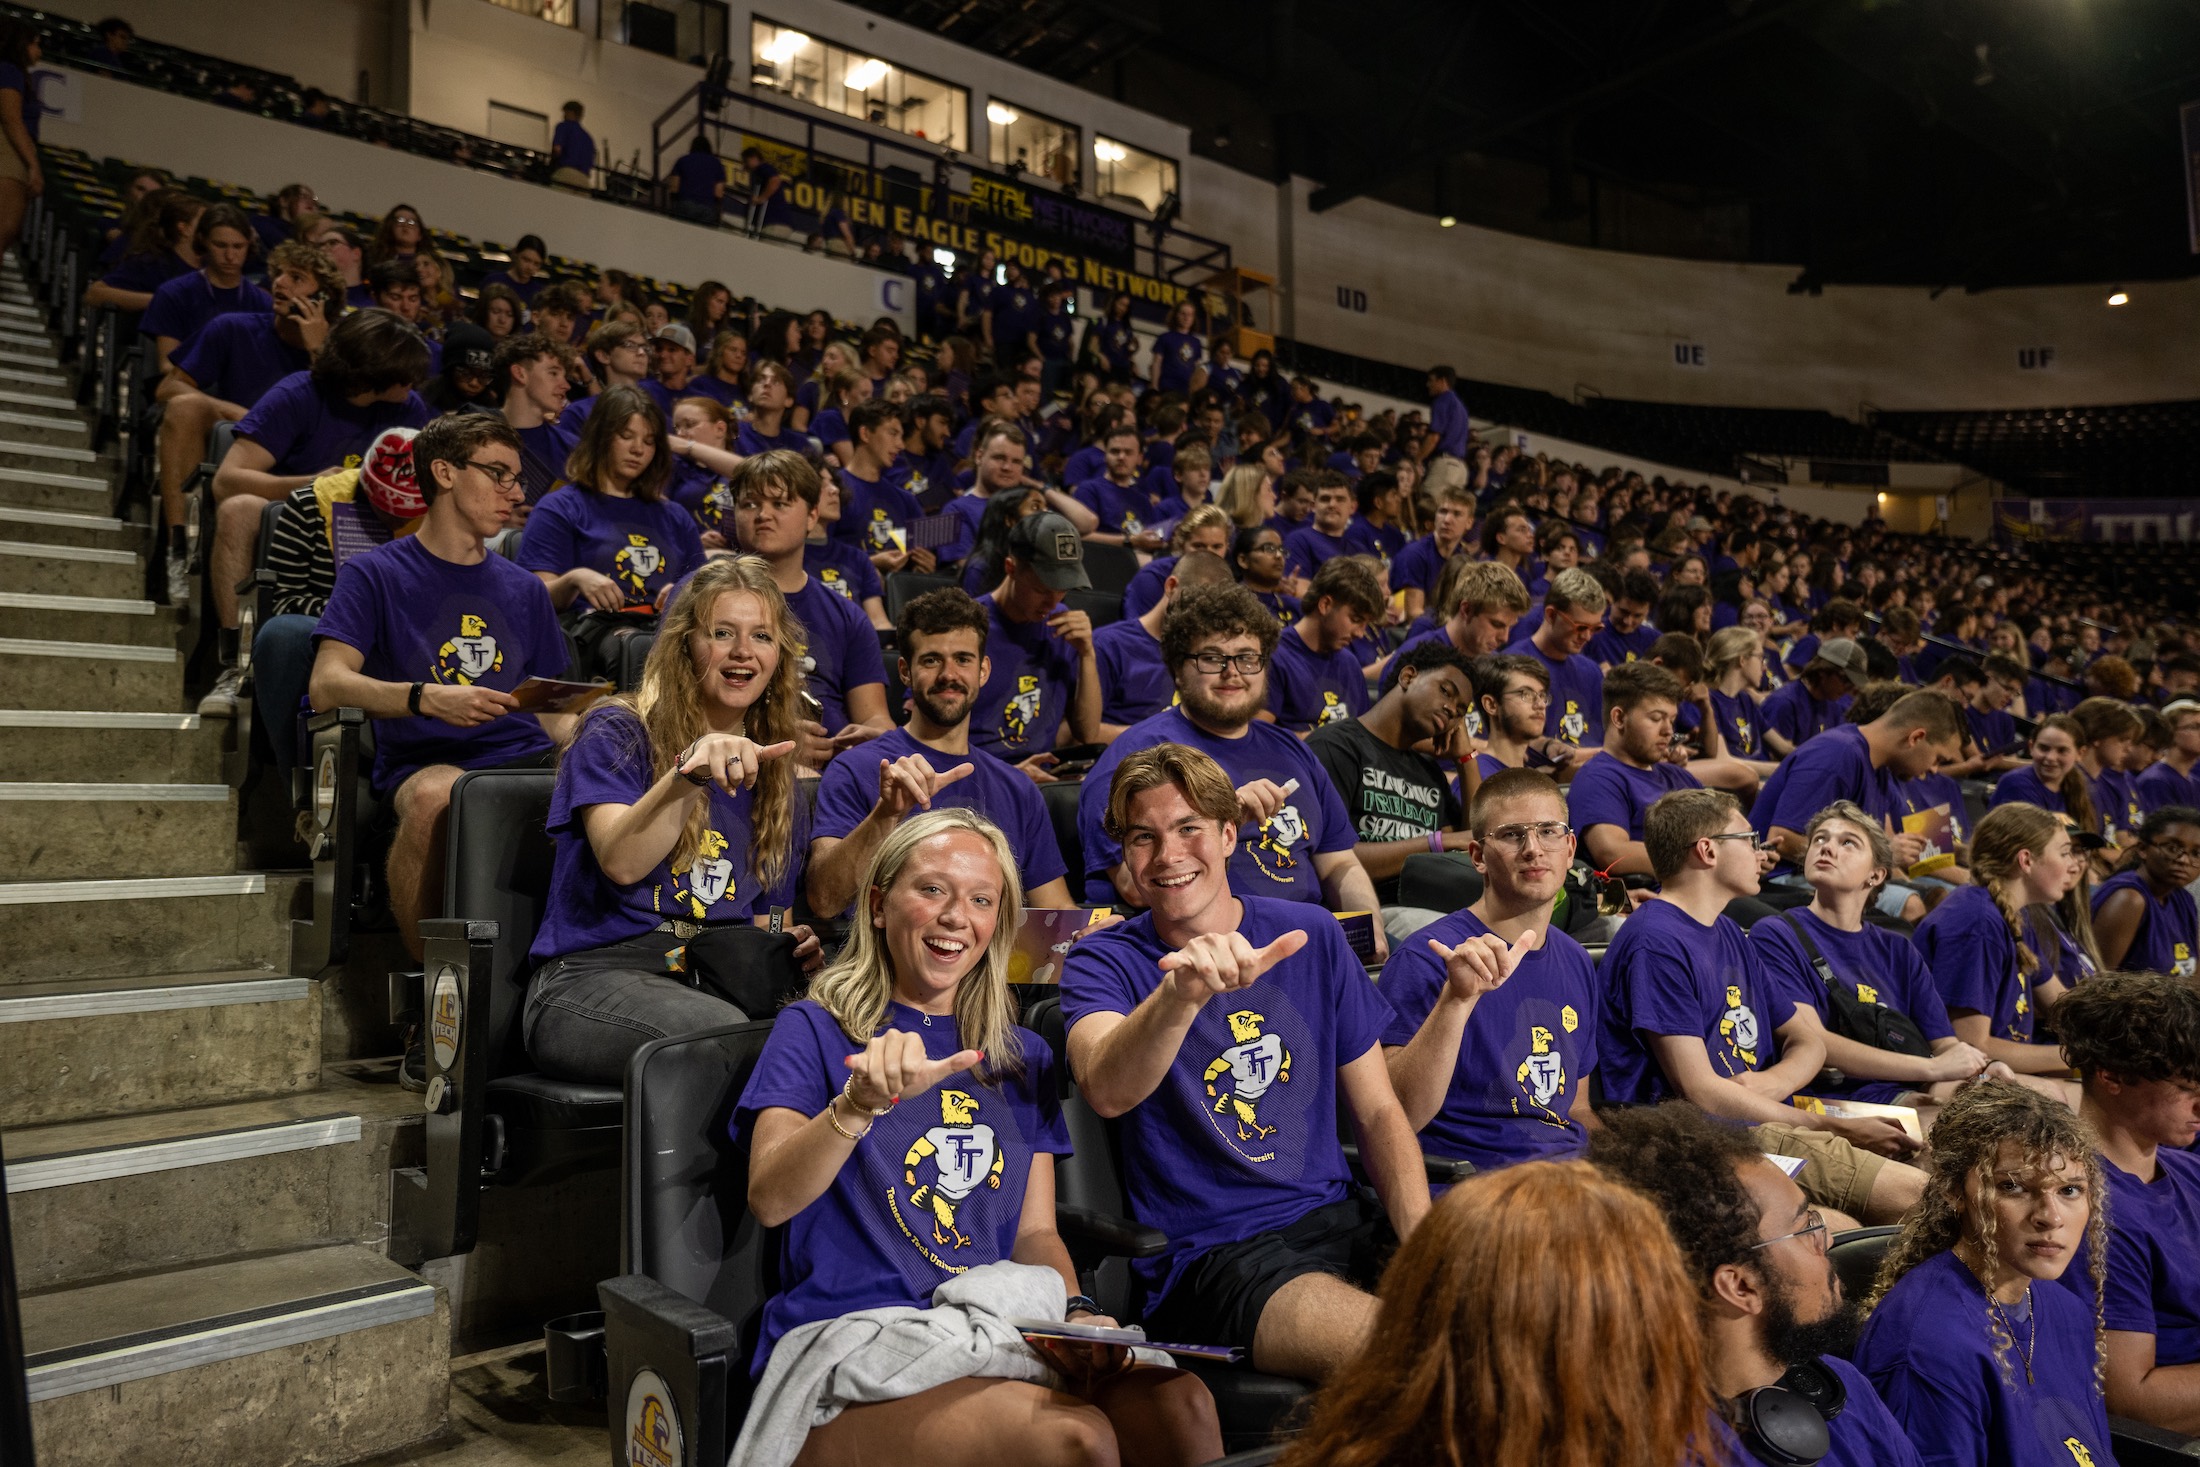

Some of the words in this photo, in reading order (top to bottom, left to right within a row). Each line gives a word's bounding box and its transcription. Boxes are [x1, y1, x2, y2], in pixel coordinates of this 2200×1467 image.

[1032, 195, 1130, 240] NETWORK
[893, 204, 981, 253] EAGLE
[1083, 256, 1191, 305] NETWORK
[883, 279, 905, 312] C
[1336, 285, 1367, 313] UD
[1675, 344, 1705, 366] UE
[2018, 347, 2054, 370] UF
[634, 549, 654, 570] TT
[463, 642, 489, 668] TT
[1276, 812, 1296, 837] TT
[435, 1022, 457, 1040] TECH
[1240, 1045, 1273, 1083] TT
[1533, 1060, 1556, 1093] TT
[946, 1134, 984, 1182] TT
[886, 1186, 912, 1238] Tennessee
[910, 1235, 929, 1258] Tech
[929, 1252, 969, 1275] University
